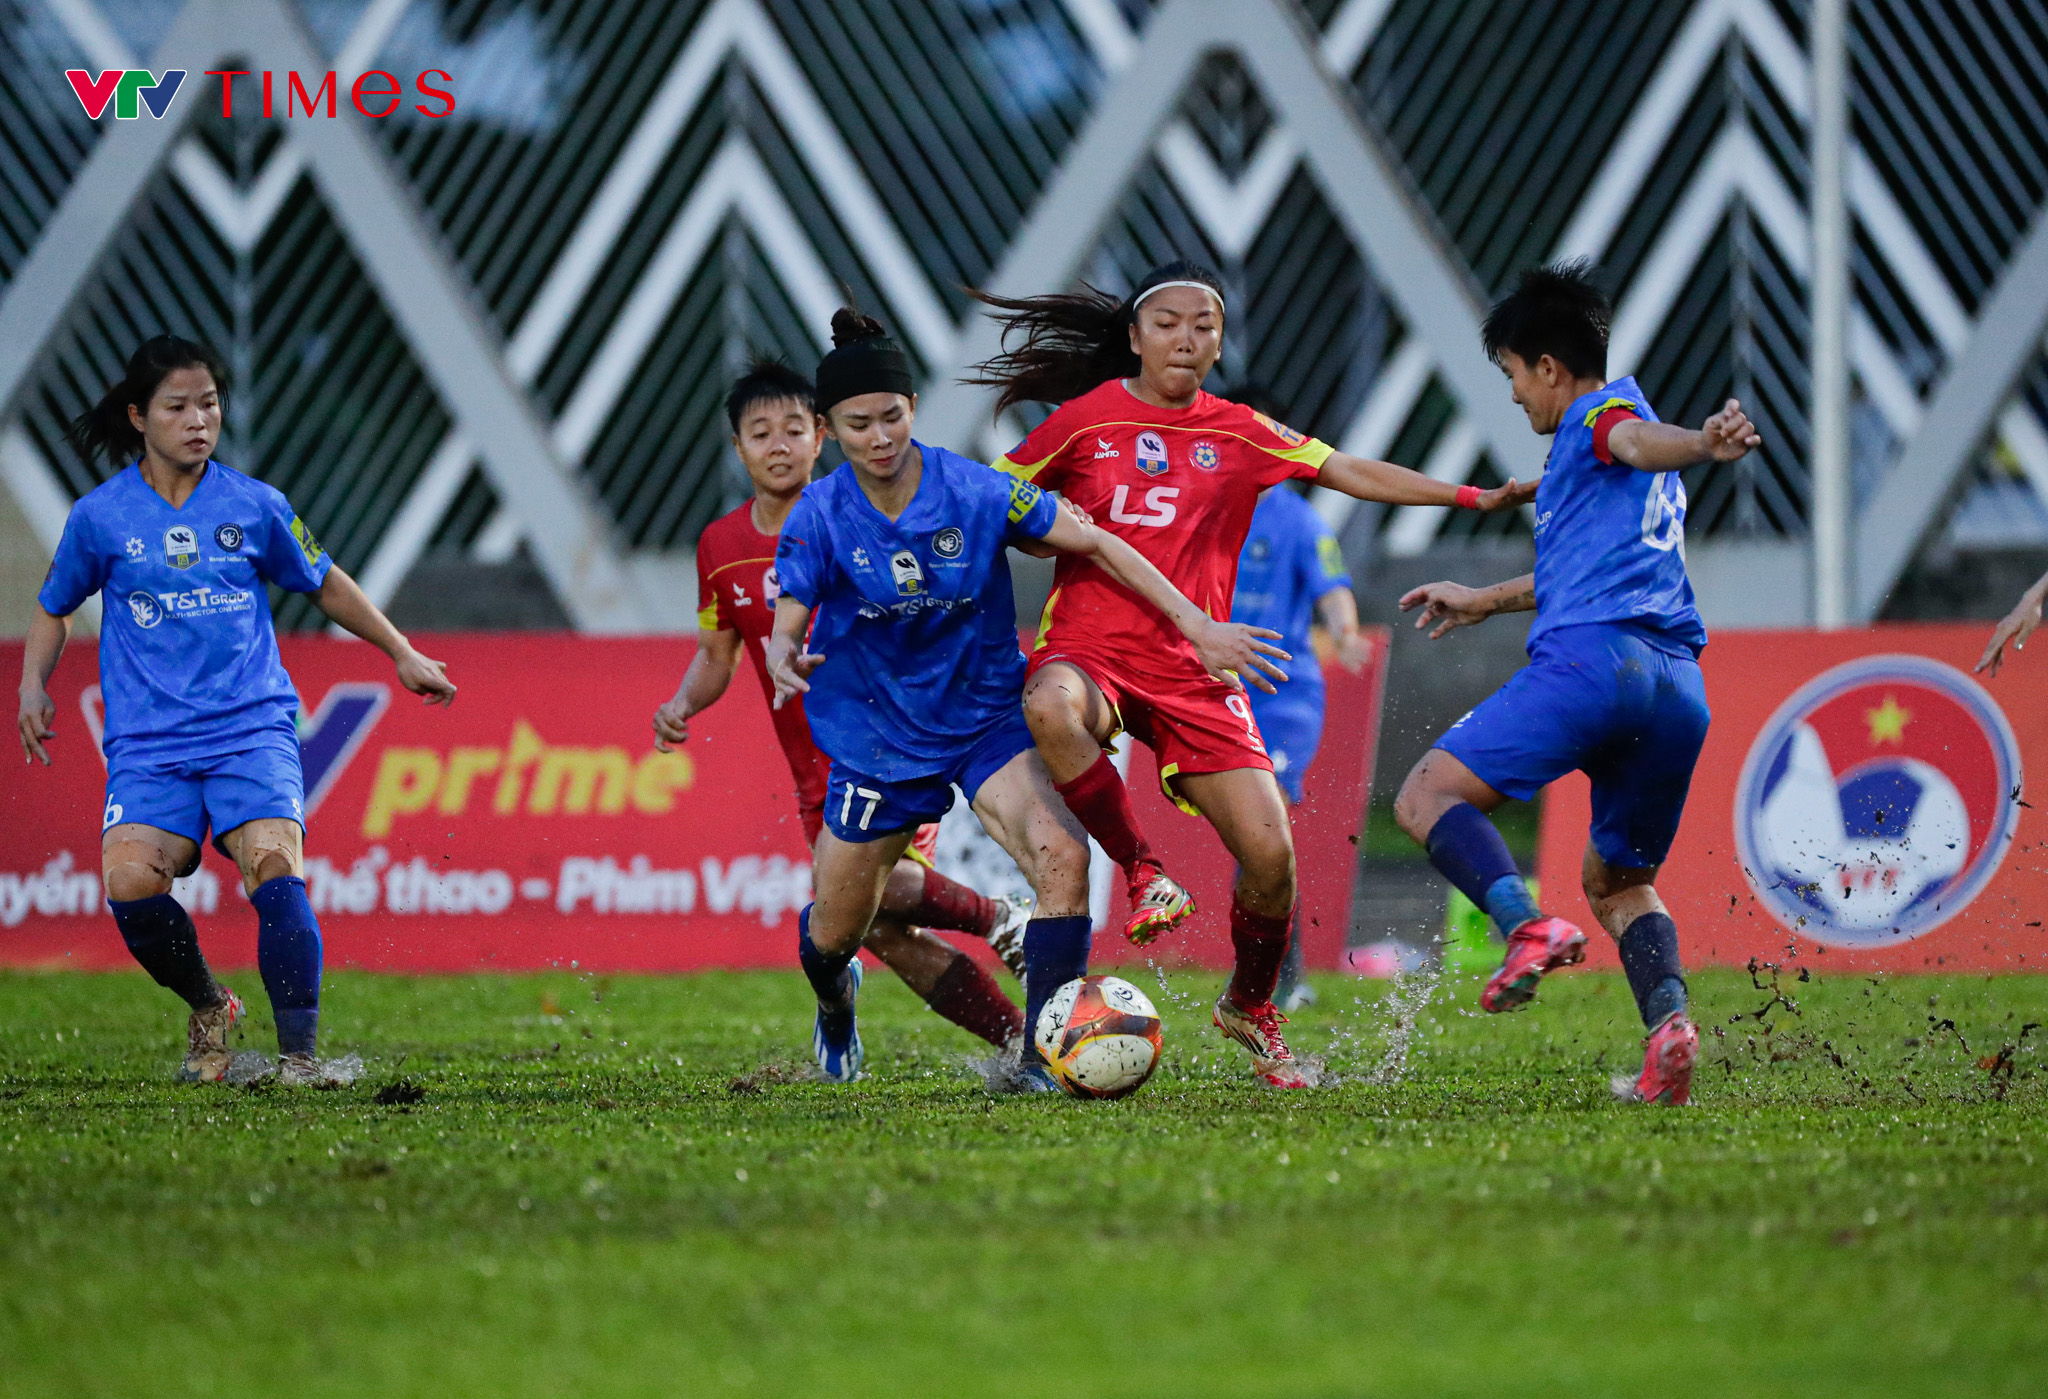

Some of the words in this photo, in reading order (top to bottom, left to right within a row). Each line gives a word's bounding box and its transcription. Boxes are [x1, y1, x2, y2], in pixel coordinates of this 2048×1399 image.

[1110, 484, 1180, 528] LS
[159, 588, 211, 612] T&T
[210, 592, 249, 605] GROUP
[1225, 694, 1254, 733] 9
[363, 718, 697, 838] prime
[103, 793, 124, 829] 6
[840, 781, 882, 831] 17
[386, 857, 512, 914] thao
[556, 855, 697, 914] Phim
[701, 854, 813, 928] Việt
